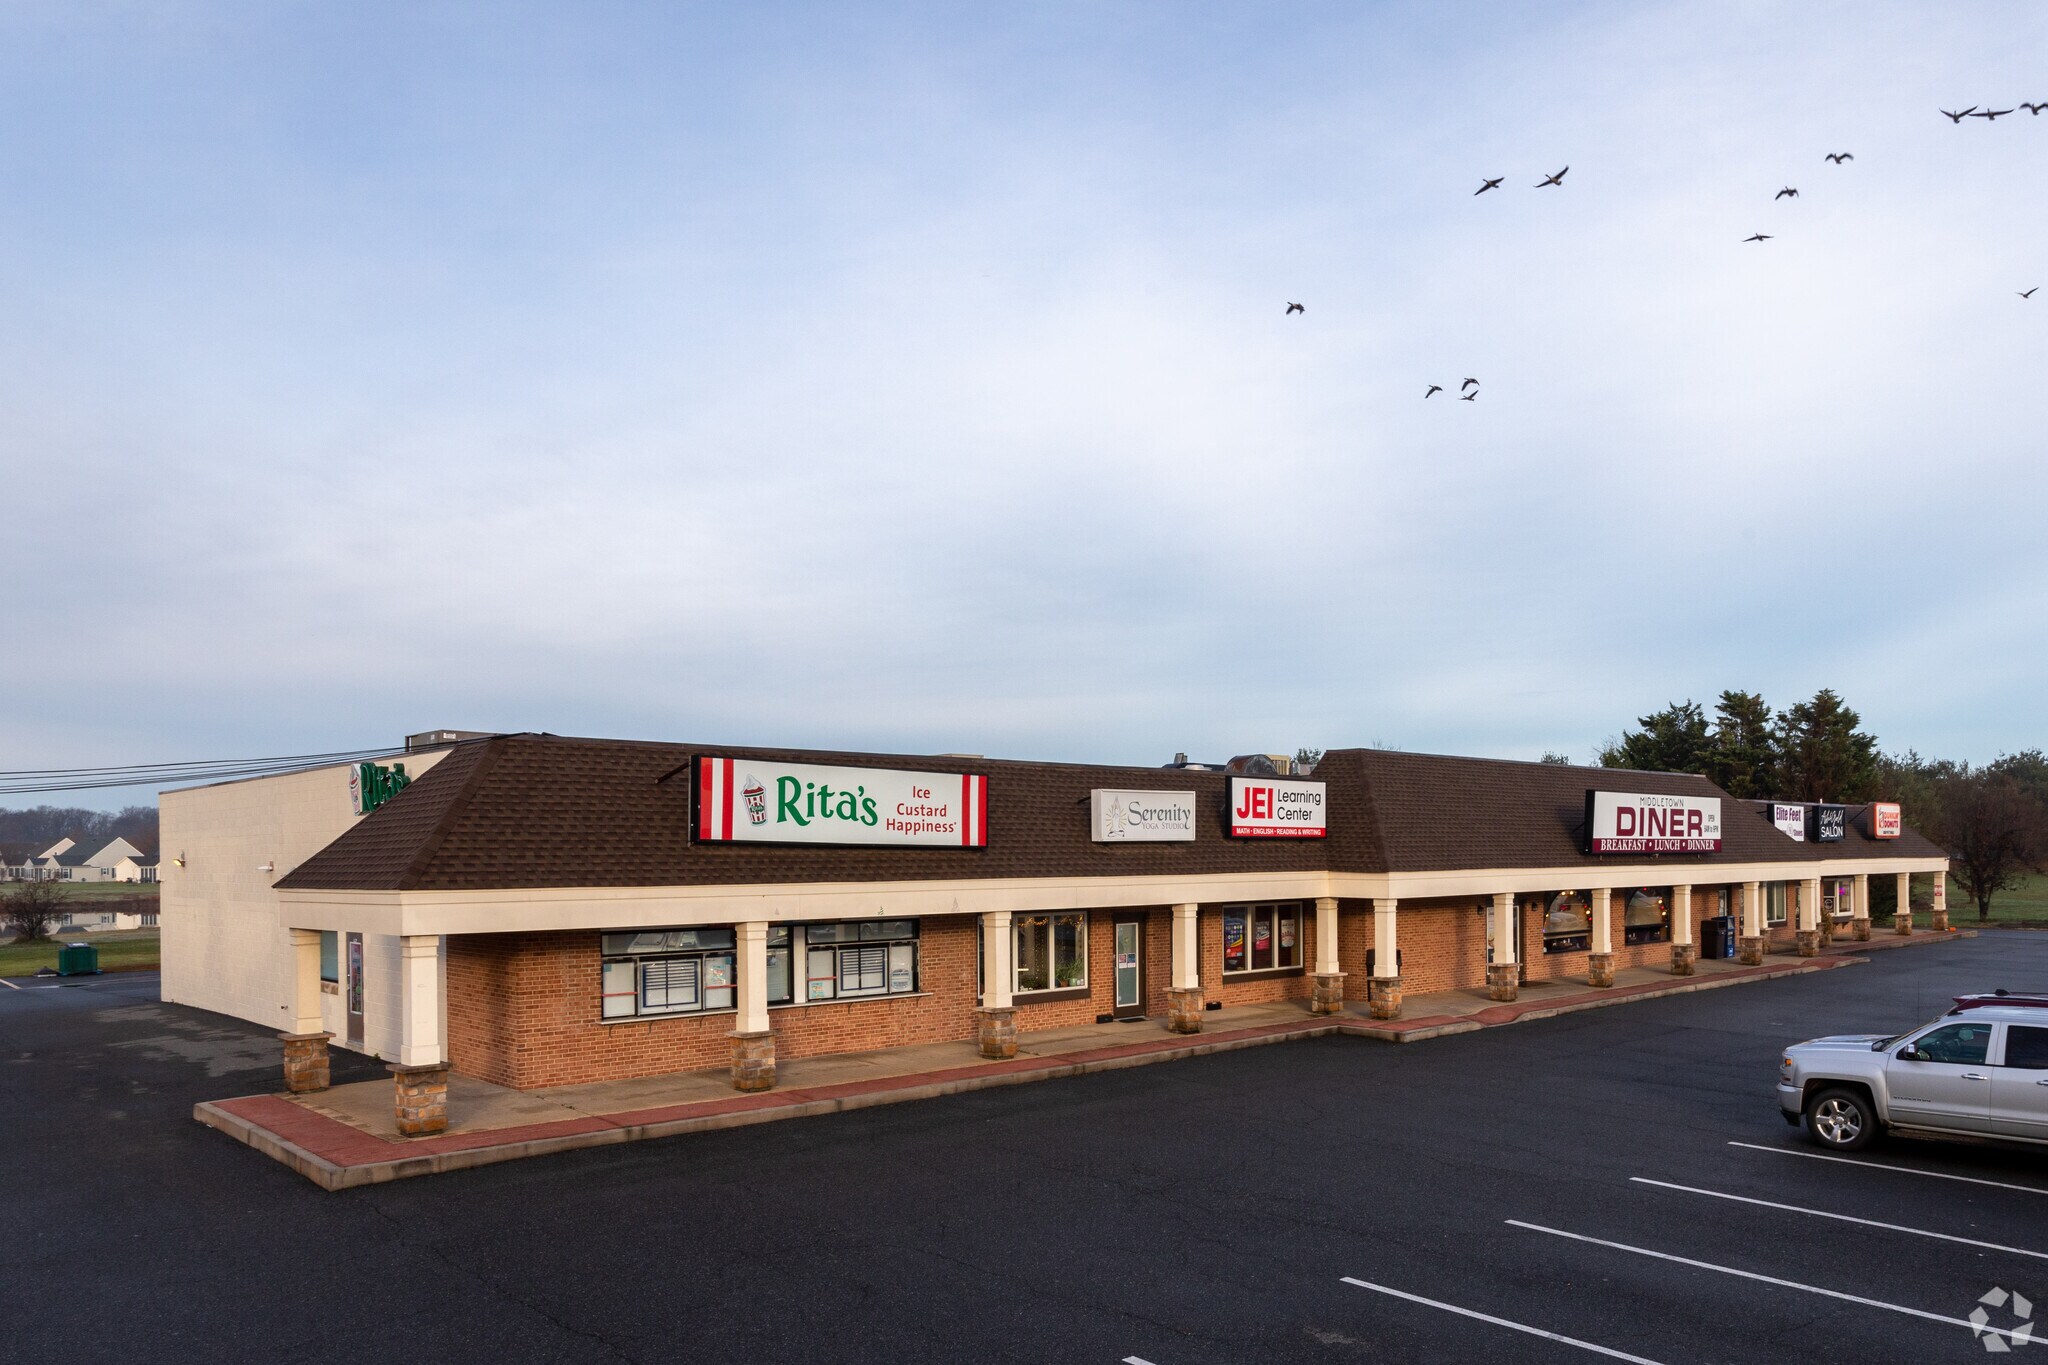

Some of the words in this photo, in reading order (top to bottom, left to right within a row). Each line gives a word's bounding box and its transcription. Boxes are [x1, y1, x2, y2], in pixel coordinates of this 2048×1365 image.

[912, 785, 931, 799] Ice
[1277, 788, 1322, 806] Learning
[776, 775, 878, 827] Rita's
[1236, 787, 1274, 819] JEI
[1640, 797, 1684, 807] MIDDLETOWN
[896, 803, 947, 817] Custard
[1127, 801, 1191, 829] Serenity
[1277, 806, 1313, 821] Center
[886, 818, 955, 836] Happiness
[1142, 822, 1160, 830] YOGA
[1162, 821, 1186, 830] STUDIO
[1616, 806, 1703, 837] DINER
[1253, 827, 1274, 835] ENGLISH
[1821, 826, 1843, 837] SALON
[1601, 840, 1647, 851] BREAKFAST
[1654, 840, 1681, 851] LUNCH
[1687, 840, 1715, 851] DINNER
